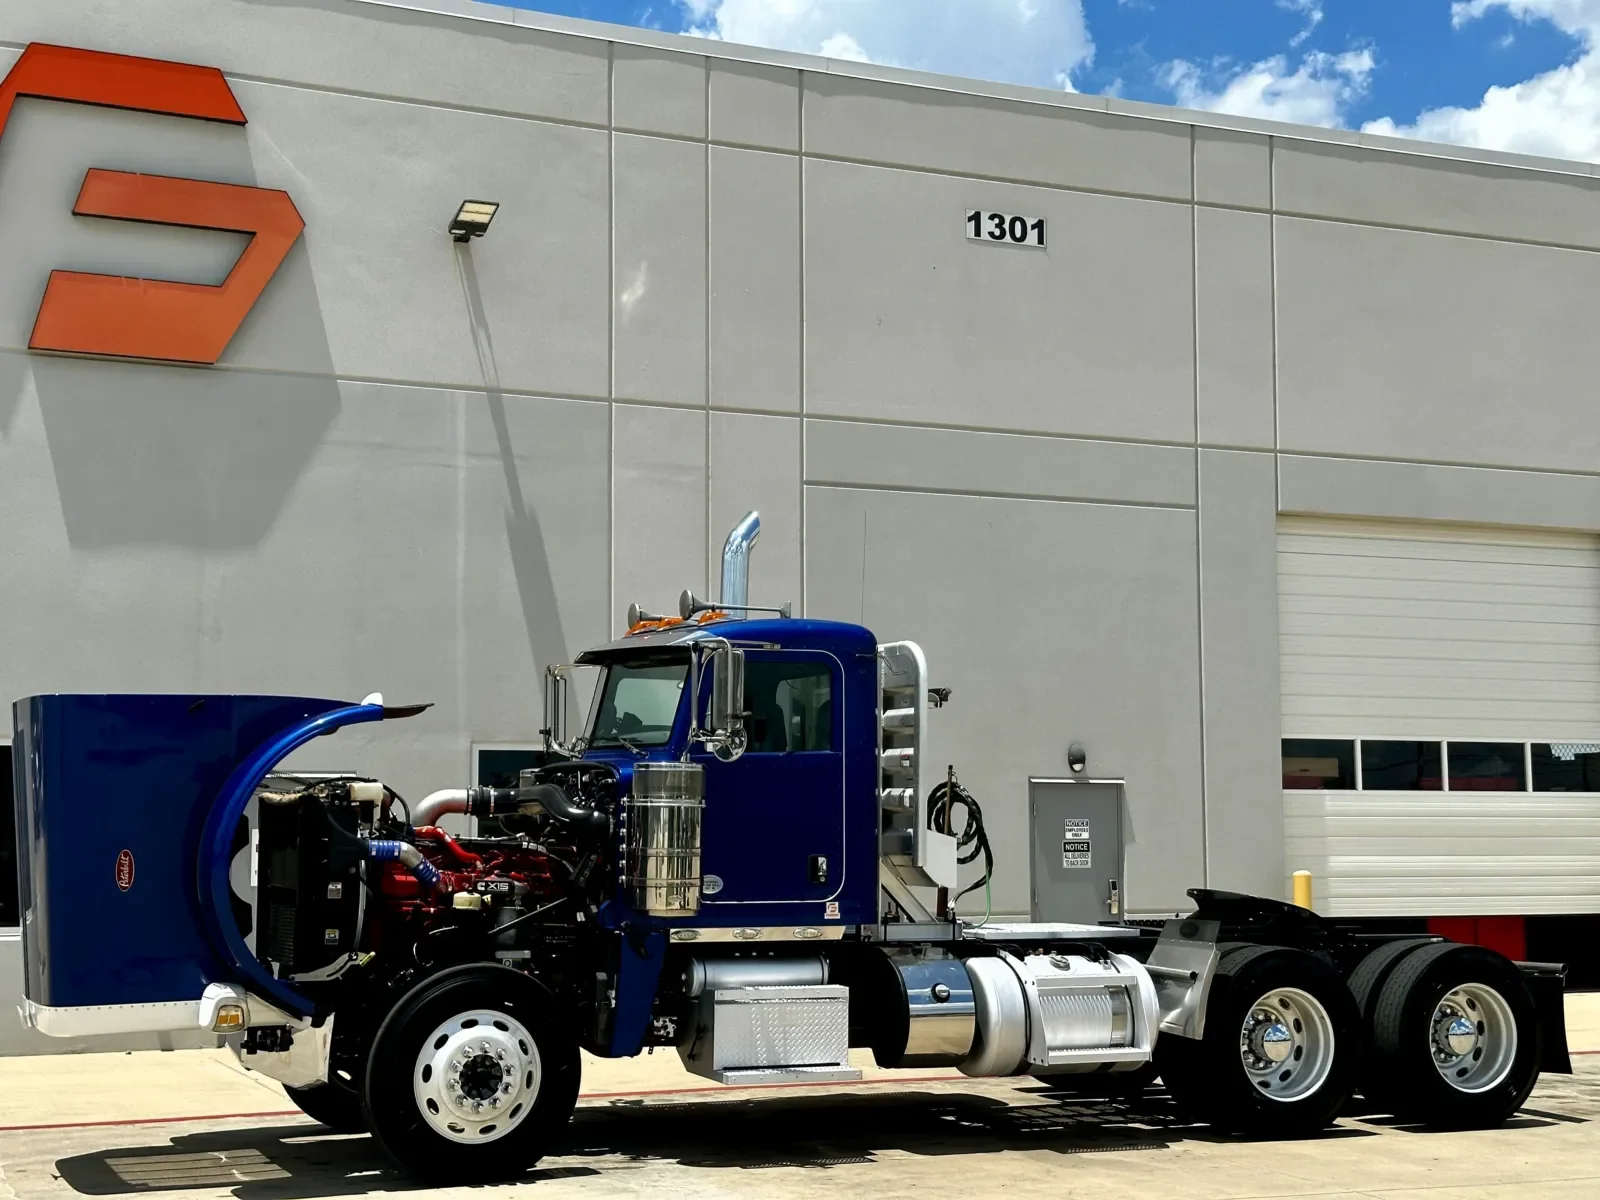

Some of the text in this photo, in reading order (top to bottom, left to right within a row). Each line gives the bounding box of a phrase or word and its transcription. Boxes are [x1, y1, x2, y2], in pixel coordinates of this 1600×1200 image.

[967, 210, 1045, 246] 1301
[1065, 843, 1089, 851] NOTICE
[118, 853, 130, 887] Peterbilt
[487, 882, 509, 892] X15
